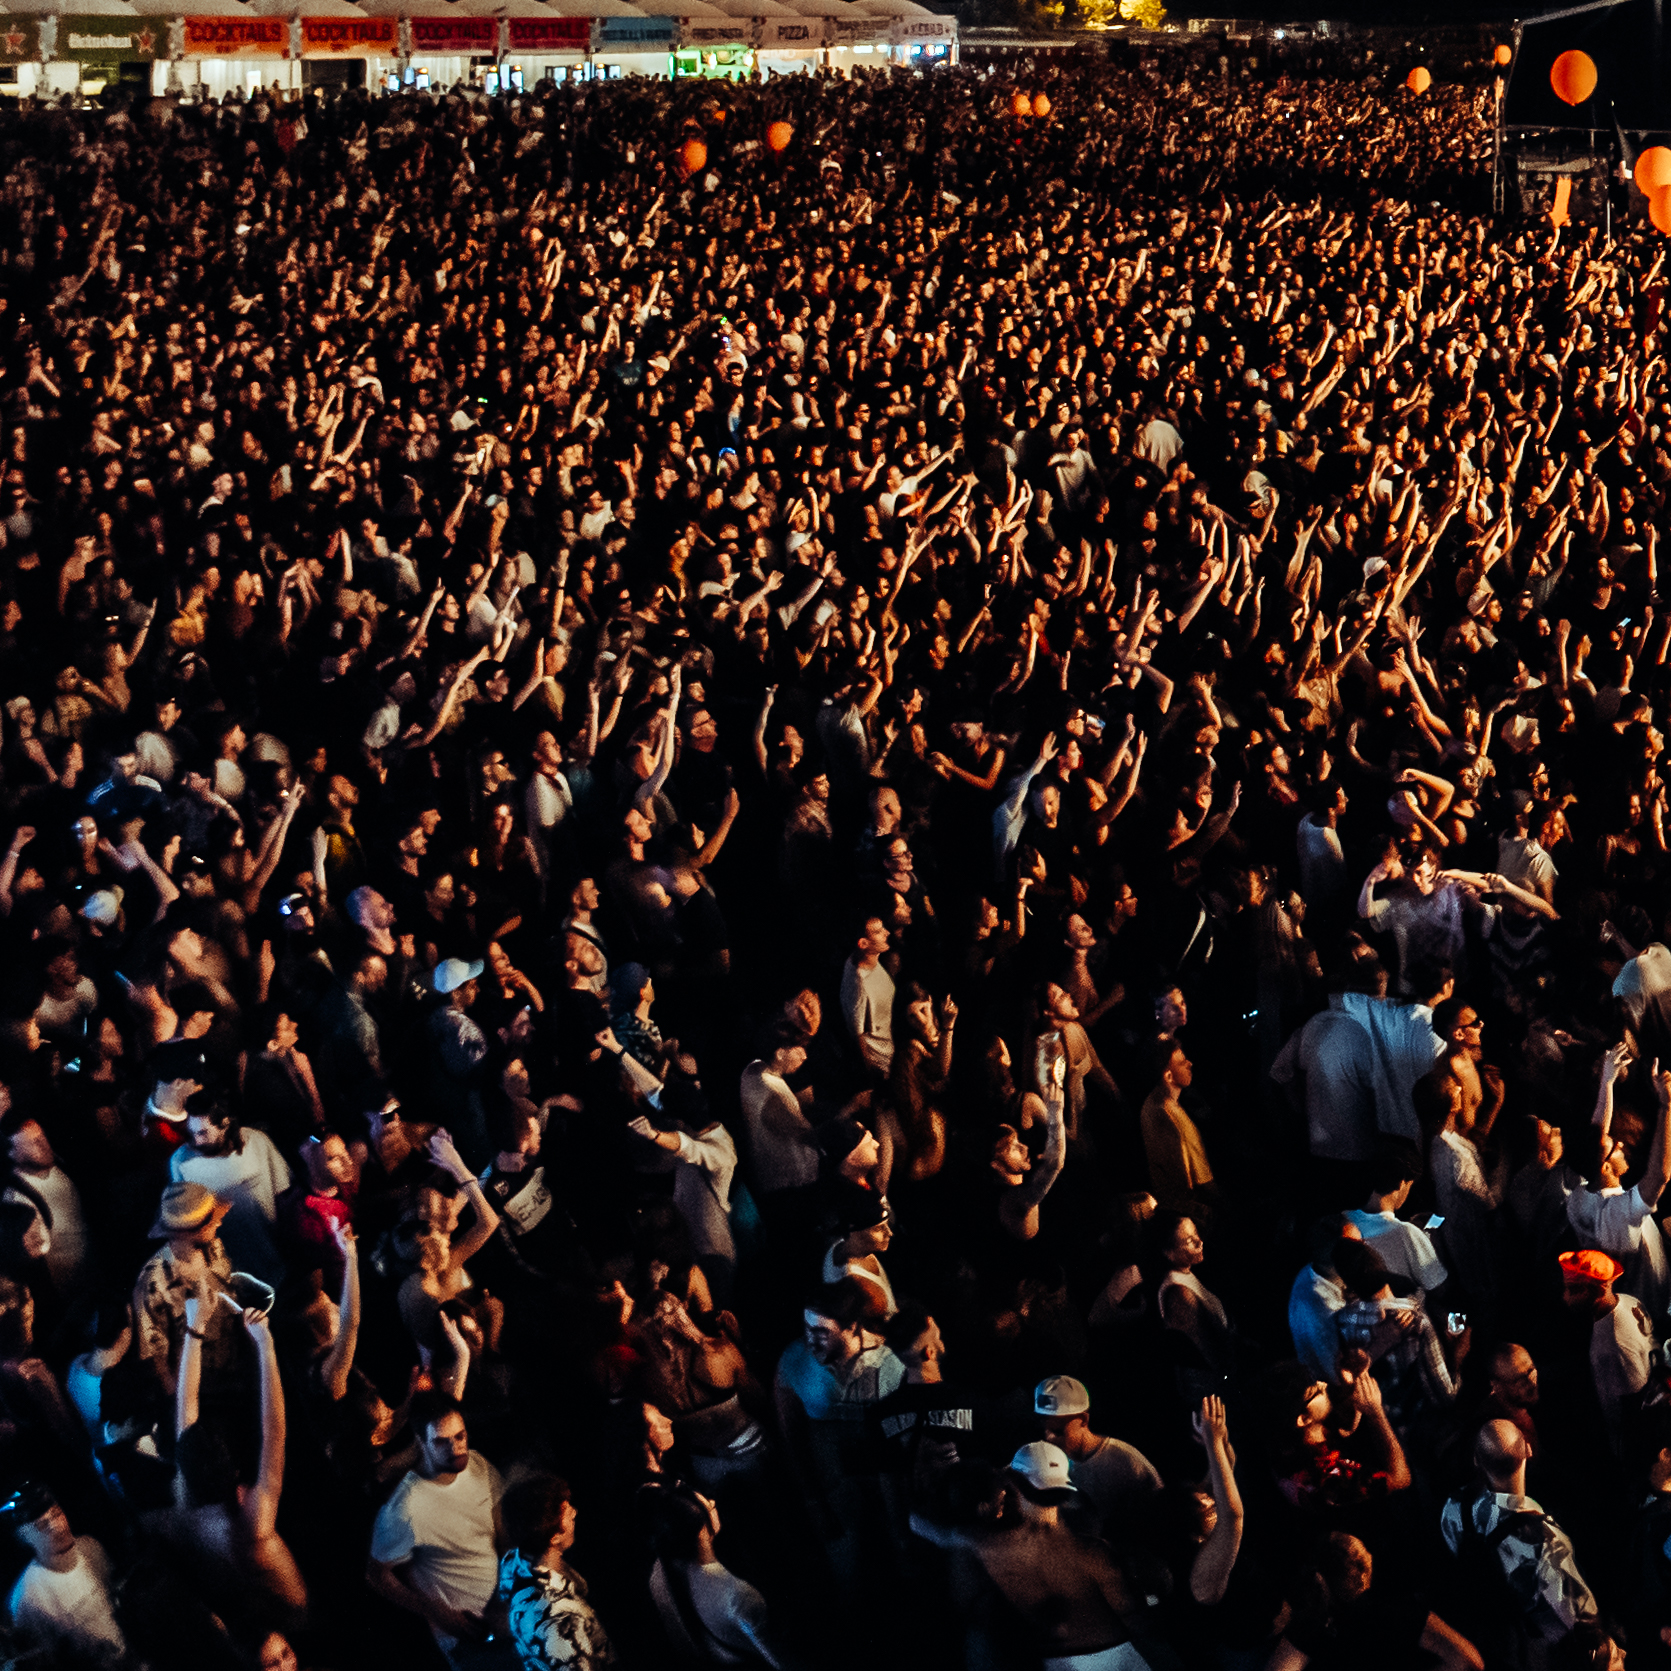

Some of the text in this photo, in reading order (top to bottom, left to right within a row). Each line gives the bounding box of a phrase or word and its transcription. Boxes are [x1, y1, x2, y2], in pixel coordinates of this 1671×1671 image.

[188, 22, 282, 43] COCKTAILS
[306, 22, 392, 42] COCKTAILS
[777, 25, 809, 40] PIZZA
